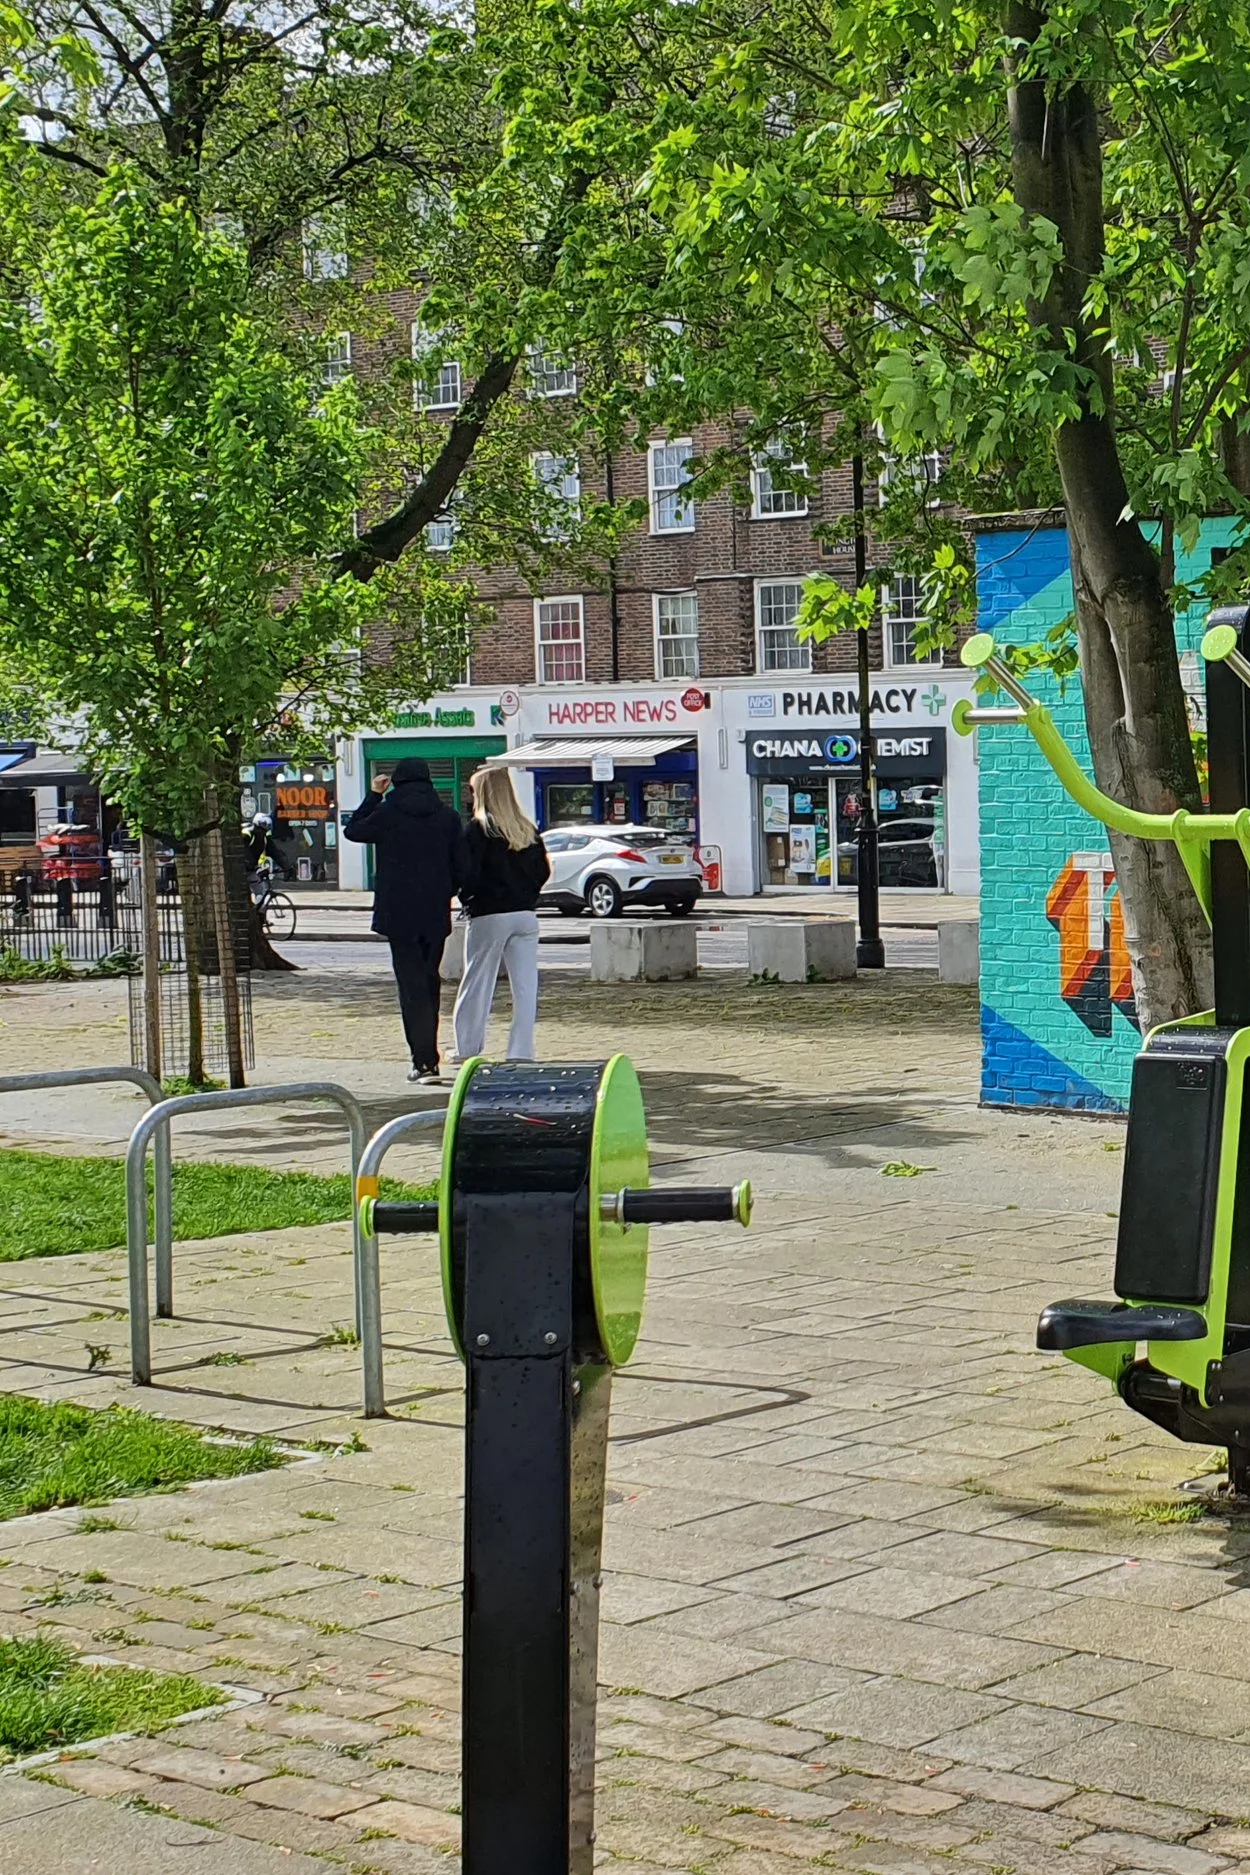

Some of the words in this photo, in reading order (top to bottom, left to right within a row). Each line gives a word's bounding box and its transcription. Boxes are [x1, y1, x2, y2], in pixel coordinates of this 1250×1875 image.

[548, 702, 617, 724] HARPER
[623, 700, 677, 722] NEWS
[683, 699, 702, 707] OFFICE
[750, 696, 772, 708] NHS
[752, 739, 823, 759] CHANA
[857, 737, 933, 757] EMIST
[275, 786, 328, 806] NOOR
